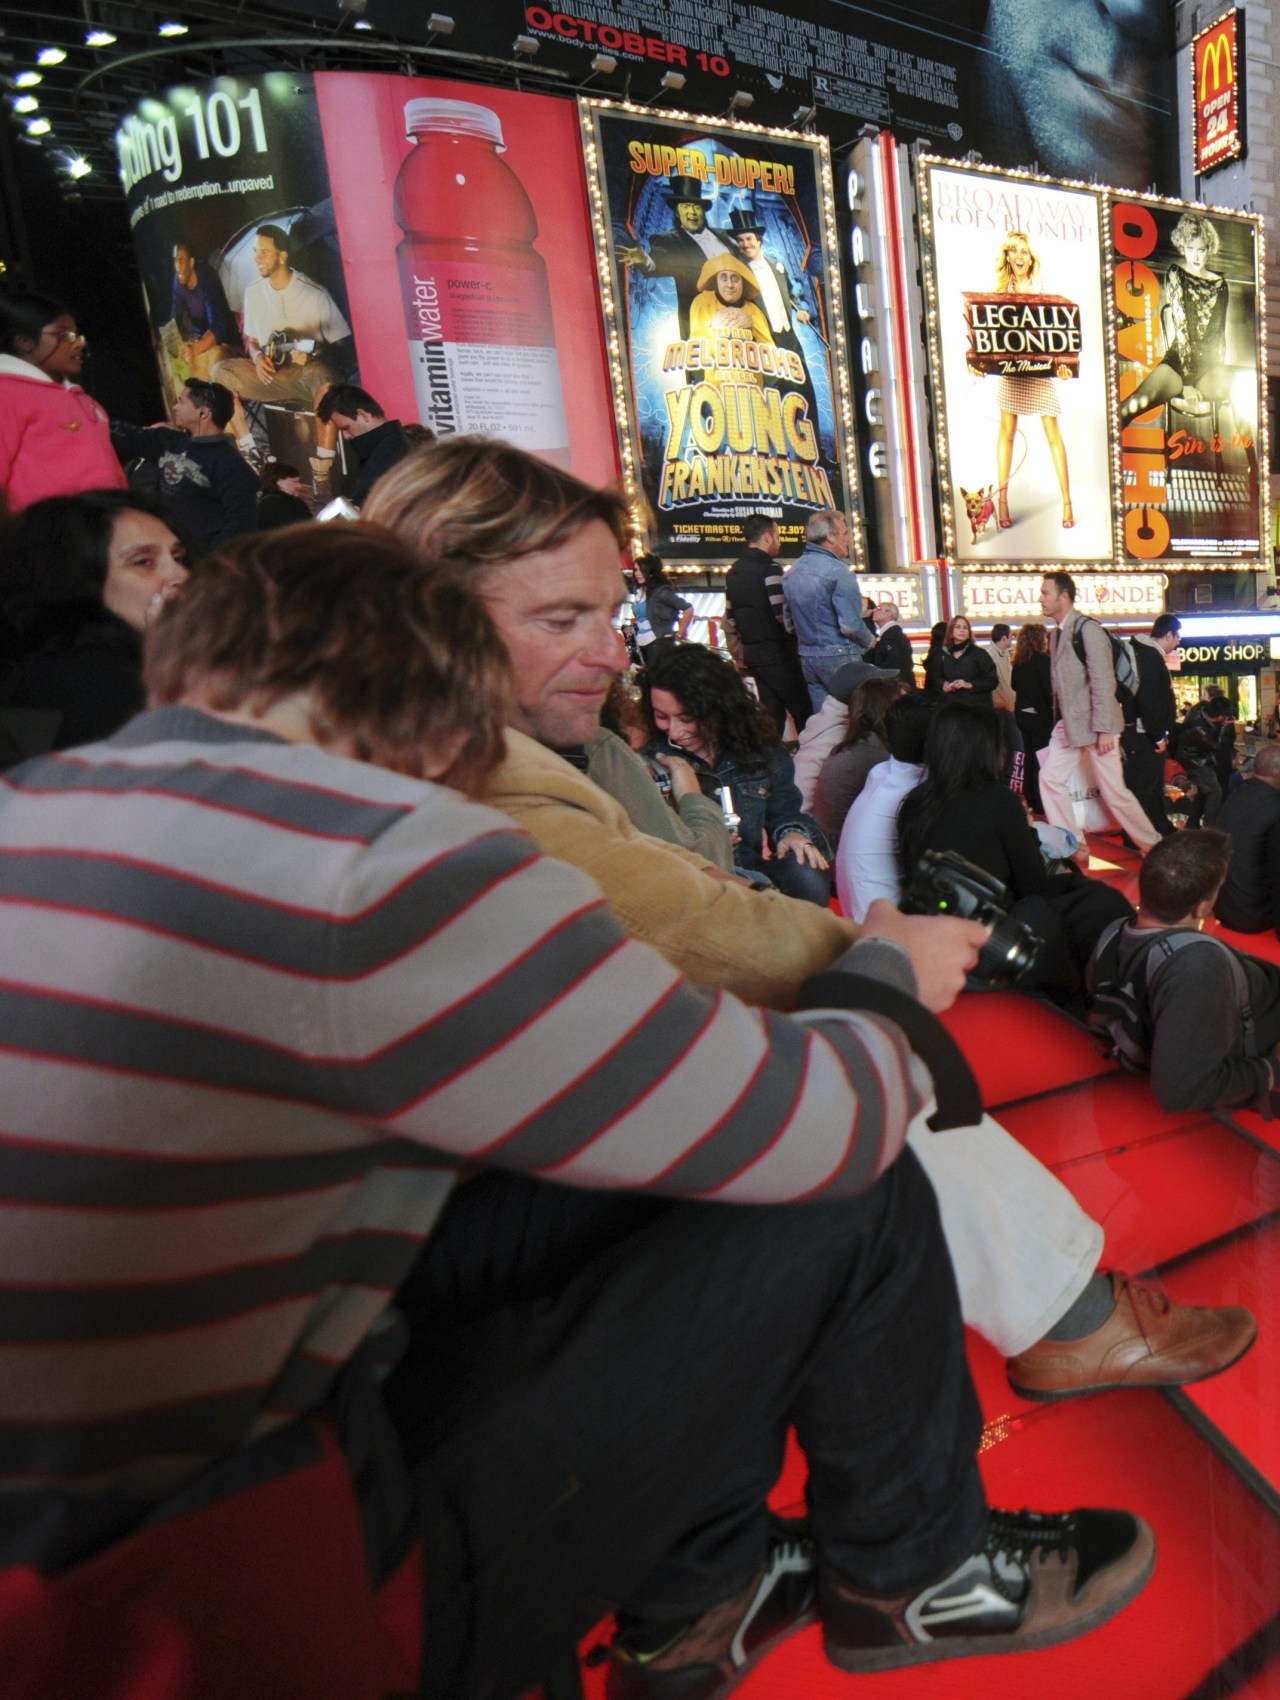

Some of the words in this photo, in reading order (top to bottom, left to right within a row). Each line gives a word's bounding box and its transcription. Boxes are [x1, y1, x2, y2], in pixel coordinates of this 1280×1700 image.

[525, 6, 688, 67] OCTOBER
[696, 52, 731, 77] 10
[527, 27, 645, 63] www.body-of-lies.com
[560, 1, 597, 21] WILLIAM
[600, 10, 640, 33] MONAHAN
[670, 29, 700, 50] DONALD
[764, 54, 788, 74] RIDLEY
[788, 61, 808, 80] SCOTT
[656, 8, 699, 33] ALEXANDER
[700, 19, 719, 38] WITT
[750, 35, 780, 56] MICHAEL
[780, 44, 814, 67] COSTIGAN
[815, 54, 844, 76] CHARLES
[855, 65, 886, 89] SCHLISSEL
[915, 86, 933, 102] DAVID
[669, 0, 694, 17] SIMON
[695, 6, 733, 28] McBURNEY
[788, 31, 808, 50] YATES
[824, 42, 844, 61] MARC
[901, 66, 921, 84] PIETRO
[750, 5, 785, 29] LEONARDO
[818, 26, 845, 48] RUSSELL
[847, 34, 868, 55] CROWE
[917, 56, 934, 74] MARK
[934, 61, 957, 82] STRONG
[814, 75, 830, 92] R
[1203, 90, 1231, 118] OPEN
[185, 88, 268, 159] 101
[1207, 108, 1229, 141] 24
[1201, 130, 1236, 161] HOURS
[628, 140, 795, 196] SUPER-DUPER!
[937, 181, 1091, 227] BROADWAY
[937, 203, 997, 229] GOES
[1004, 214, 1092, 243] BLONDE!
[848, 169, 887, 478] PALACE
[971, 304, 1079, 329] LEGALLY
[975, 329, 1082, 353] BLONDE
[663, 338, 714, 372] MEL
[715, 338, 806, 384] BROOKS
[998, 360, 1016, 374] The
[1016, 357, 1052, 372] Musical
[468, 422, 479, 431] 20
[664, 382, 819, 464] YOUNG
[1167, 429, 1205, 460] Sin
[1210, 432, 1225, 453] is
[1231, 431, 1255, 448] in.
[659, 454, 836, 511] FRANKENSTEIN
[673, 524, 744, 534] TICKETMASTER.
[971, 587, 1042, 606] LEGAL
[1075, 585, 1156, 604] BLONDE
[1177, 646, 1220, 662] BODY
